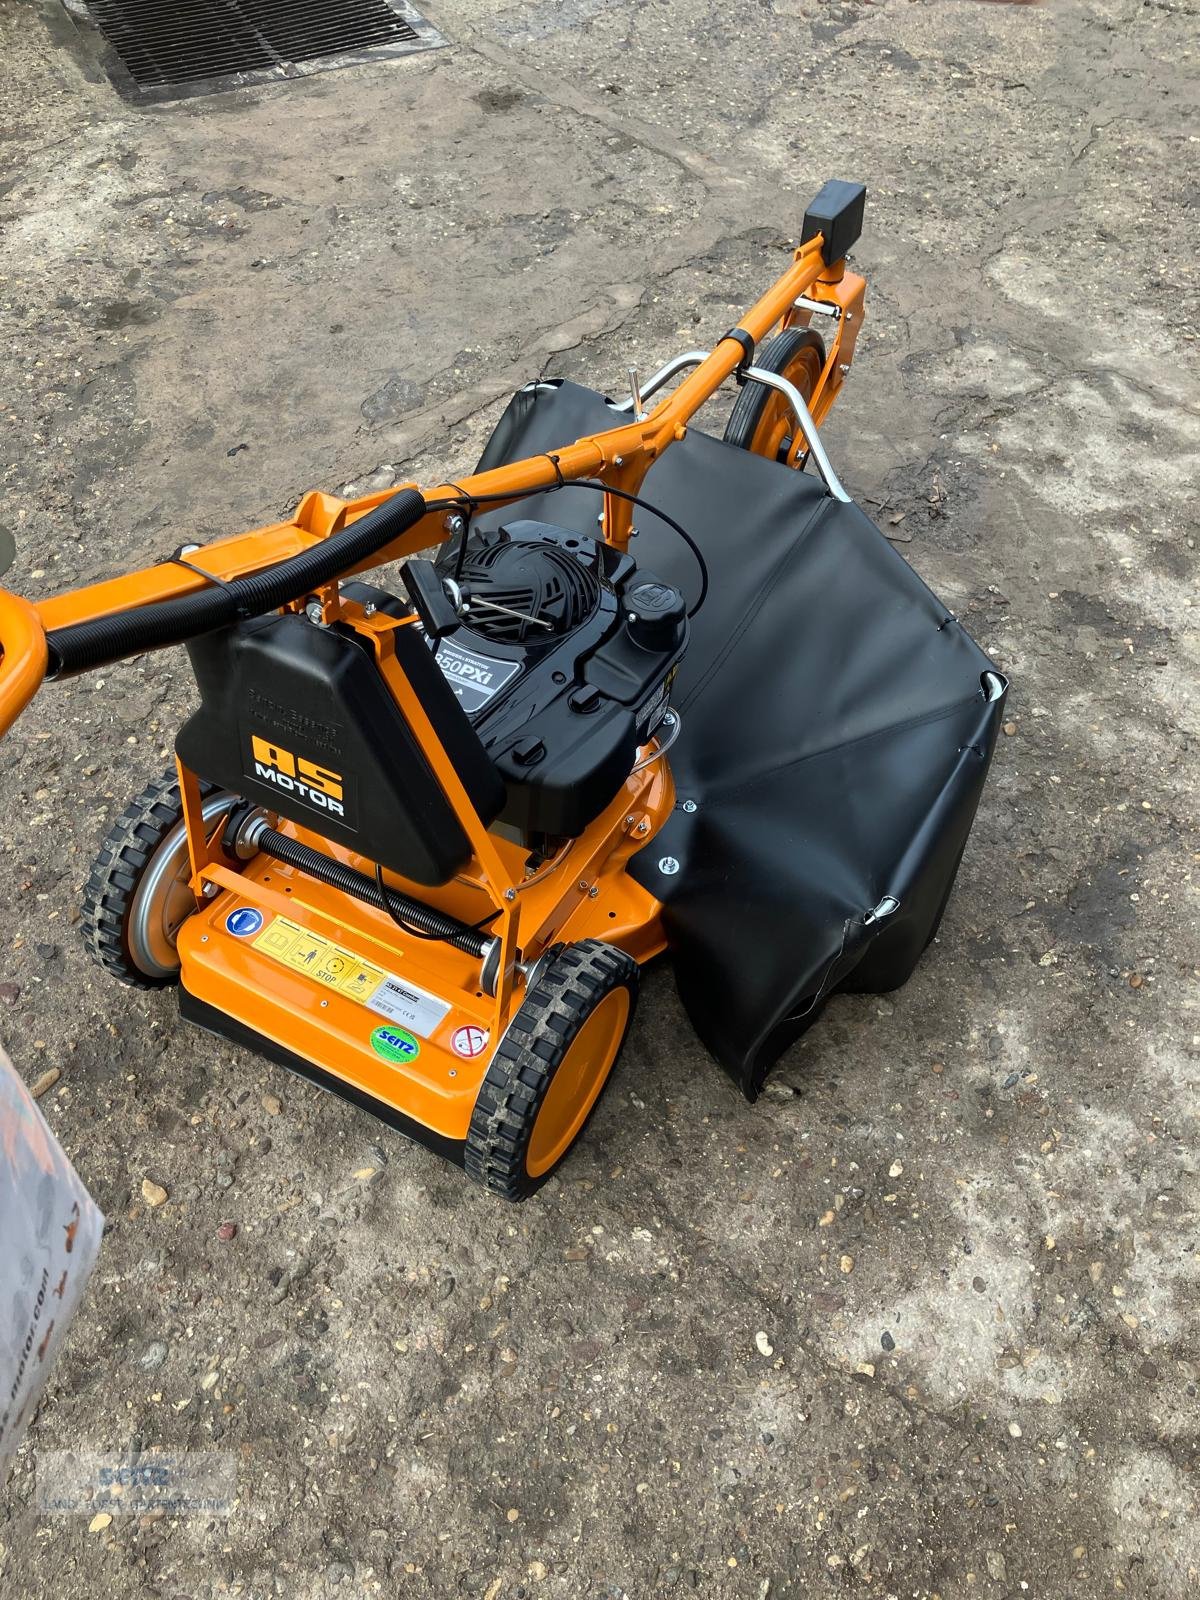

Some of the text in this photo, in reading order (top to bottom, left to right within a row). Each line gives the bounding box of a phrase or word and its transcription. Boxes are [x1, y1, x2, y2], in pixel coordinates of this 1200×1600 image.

[252, 735, 343, 801] AS
[255, 762, 345, 817] MOTOR
[316, 970, 337, 984] STOP
[379, 1030, 415, 1055] SEITZ
